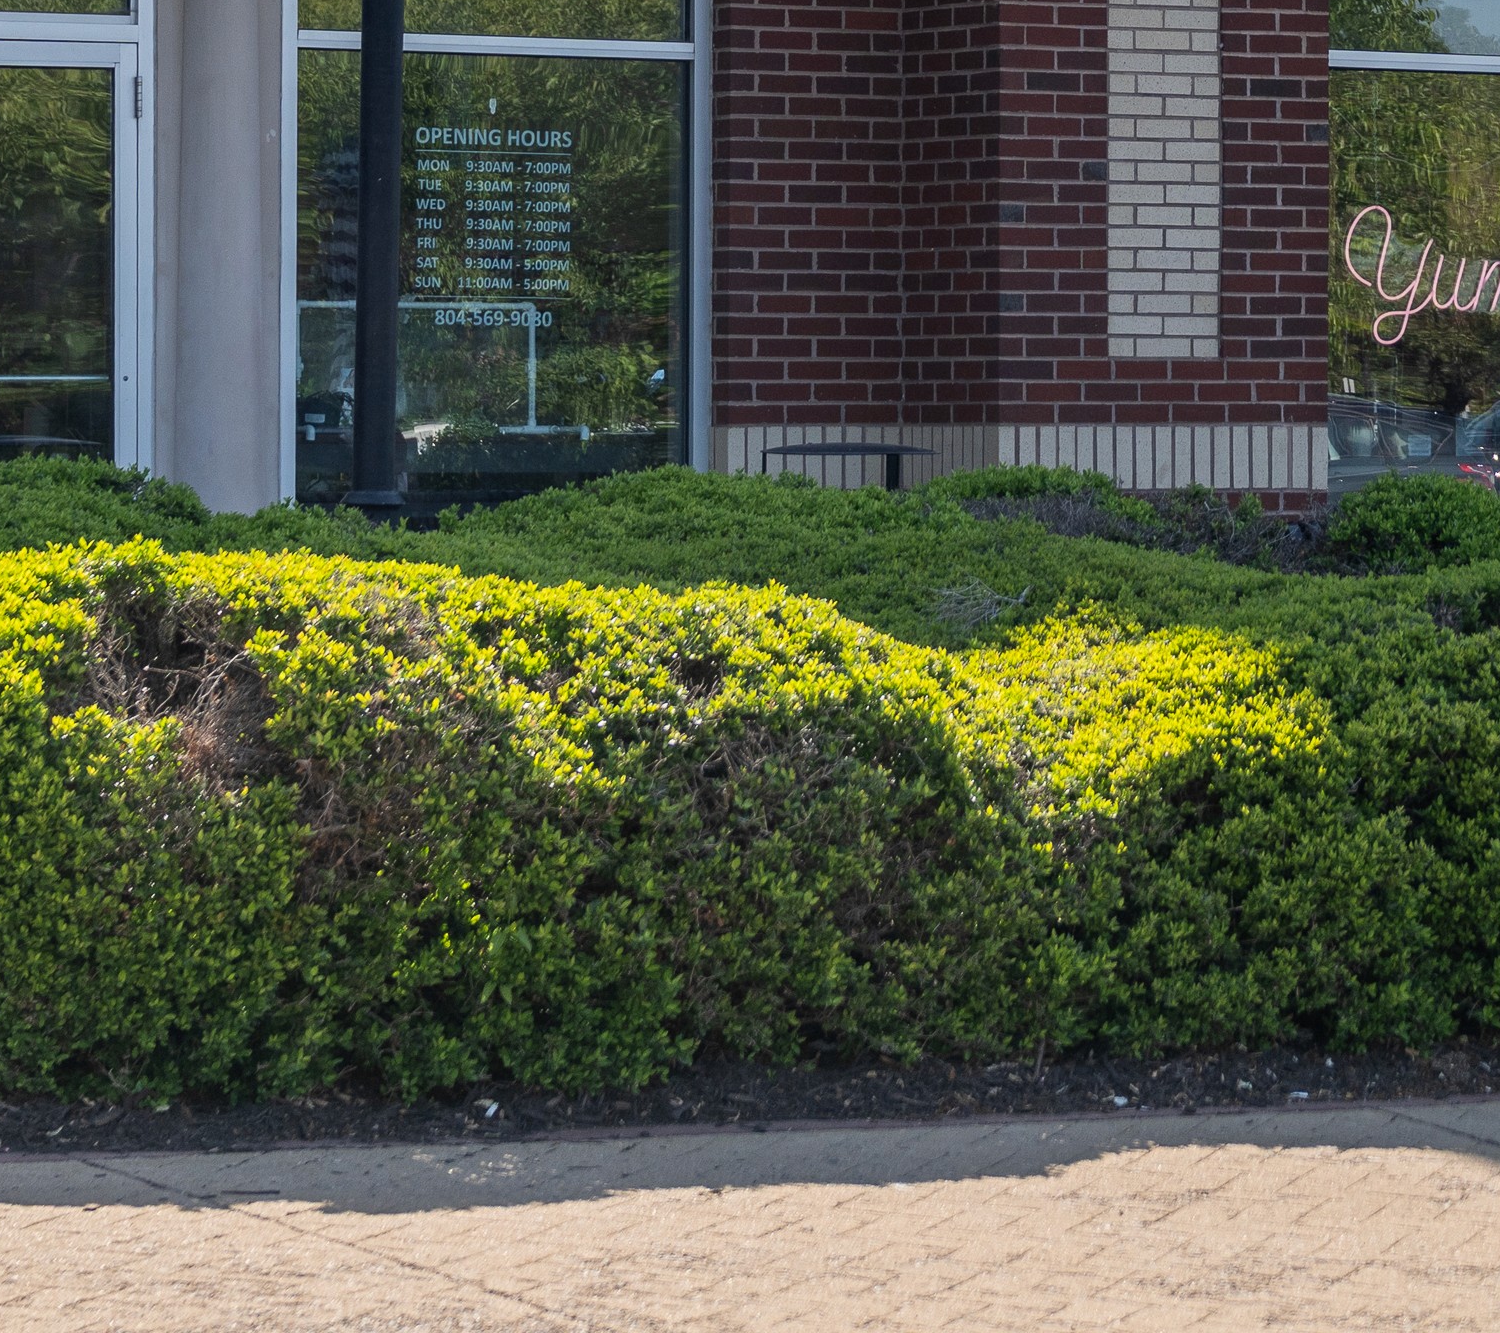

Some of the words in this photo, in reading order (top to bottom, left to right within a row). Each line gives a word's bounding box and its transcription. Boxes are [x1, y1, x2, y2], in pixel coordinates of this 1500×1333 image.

[415, 126, 501, 146] OPENING
[507, 129, 573, 148] HOURS
[417, 159, 450, 172] MON
[466, 160, 514, 173] 9:30AM
[525, 161, 571, 174] 7:00PM
[418, 179, 442, 191] TUE
[465, 179, 513, 193] 9:30AM
[524, 181, 570, 194] 7:00PM
[416, 198, 446, 210] WED
[465, 199, 514, 212] 9:30AM
[524, 200, 571, 213] 7:00PM
[416, 218, 442, 230] THU
[466, 218, 514, 231] 9:30AM
[525, 220, 571, 233] 7:00PM
[417, 237, 436, 250] FRI
[466, 237, 514, 251] 9:30AM
[524, 239, 571, 252] 7:00PM
[416, 256, 439, 269] SAT
[465, 257, 513, 270] 9:30AM
[523, 258, 570, 272] 5:00PM
[414, 276, 441, 288] SUN
[457, 276, 513, 290] 11:00AM
[523, 278, 570, 291] 5:00PM
